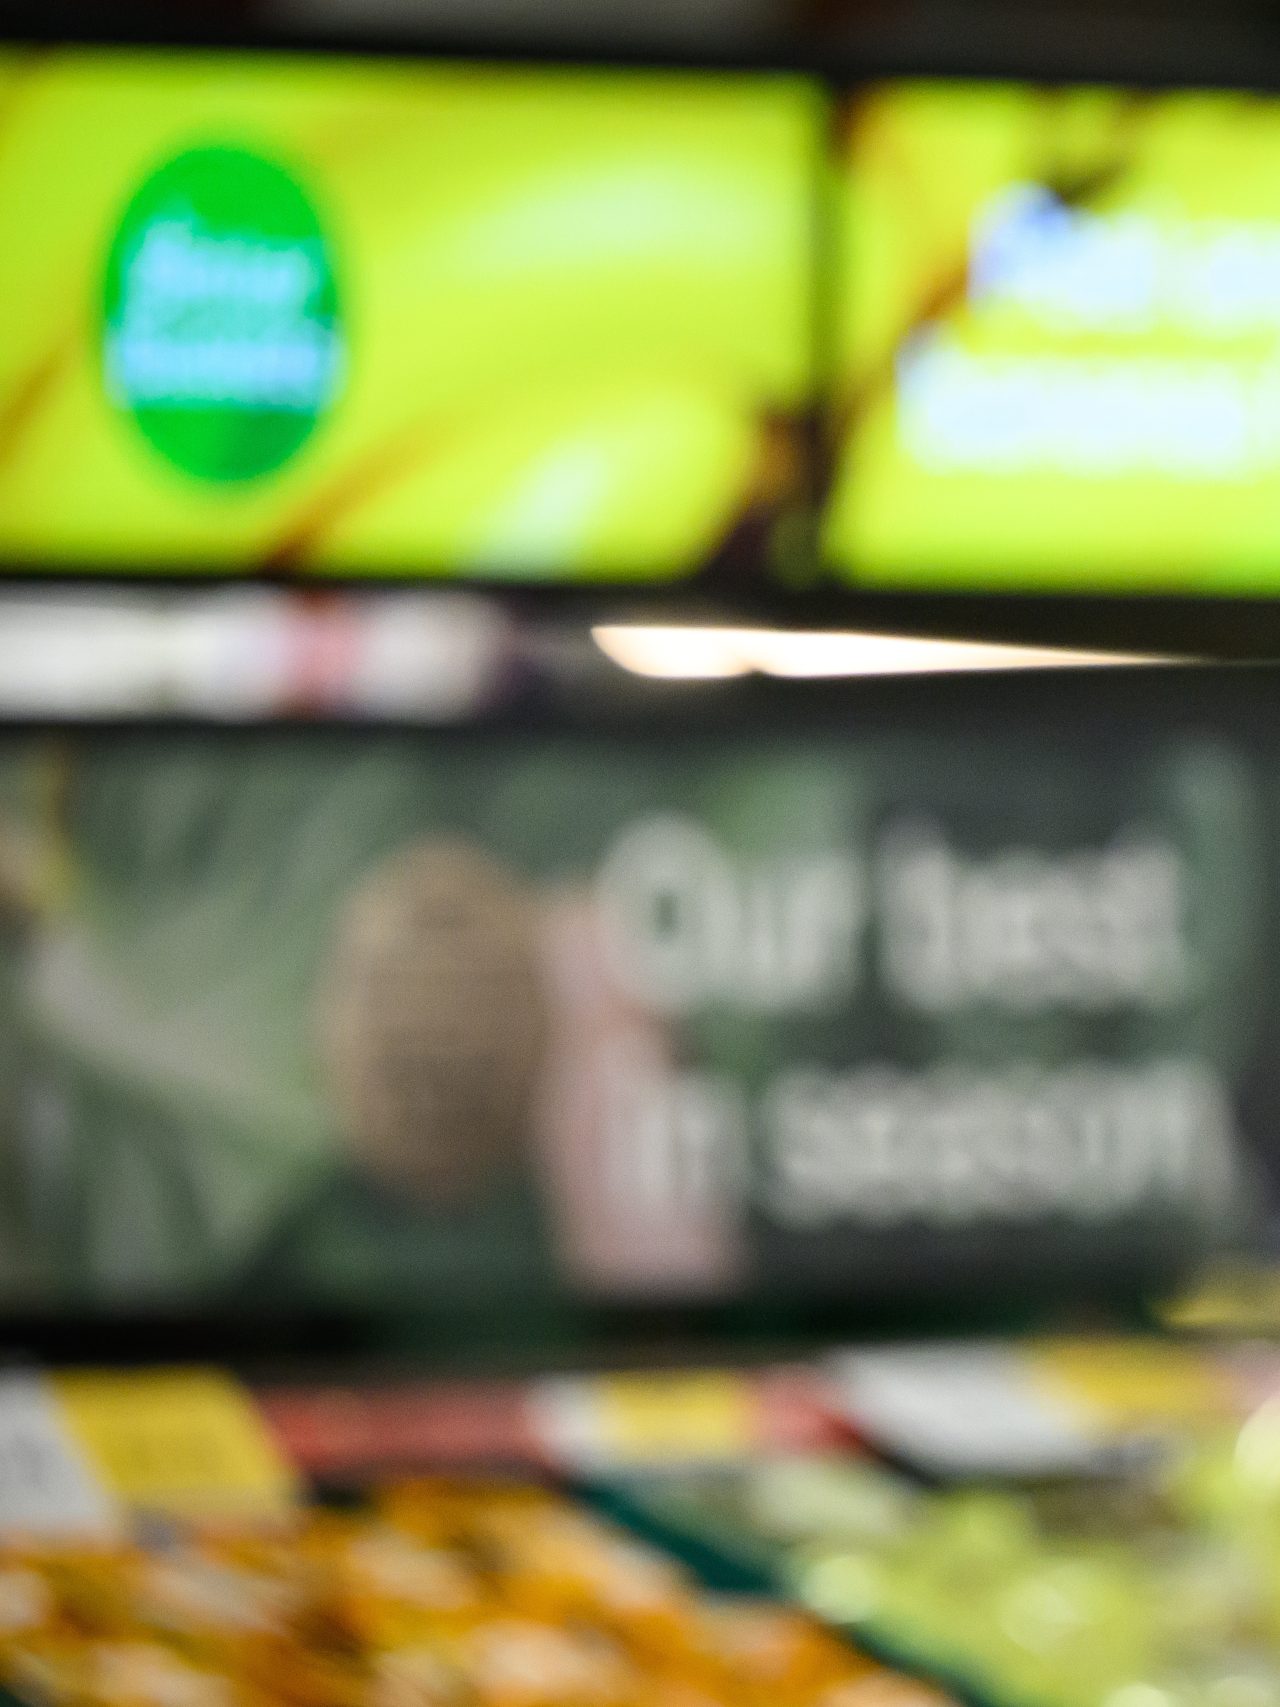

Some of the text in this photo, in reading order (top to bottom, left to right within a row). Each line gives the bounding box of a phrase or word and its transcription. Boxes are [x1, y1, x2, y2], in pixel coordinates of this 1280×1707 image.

[602, 812, 1184, 1006] Our best
[768, 1064, 1230, 1222] season
